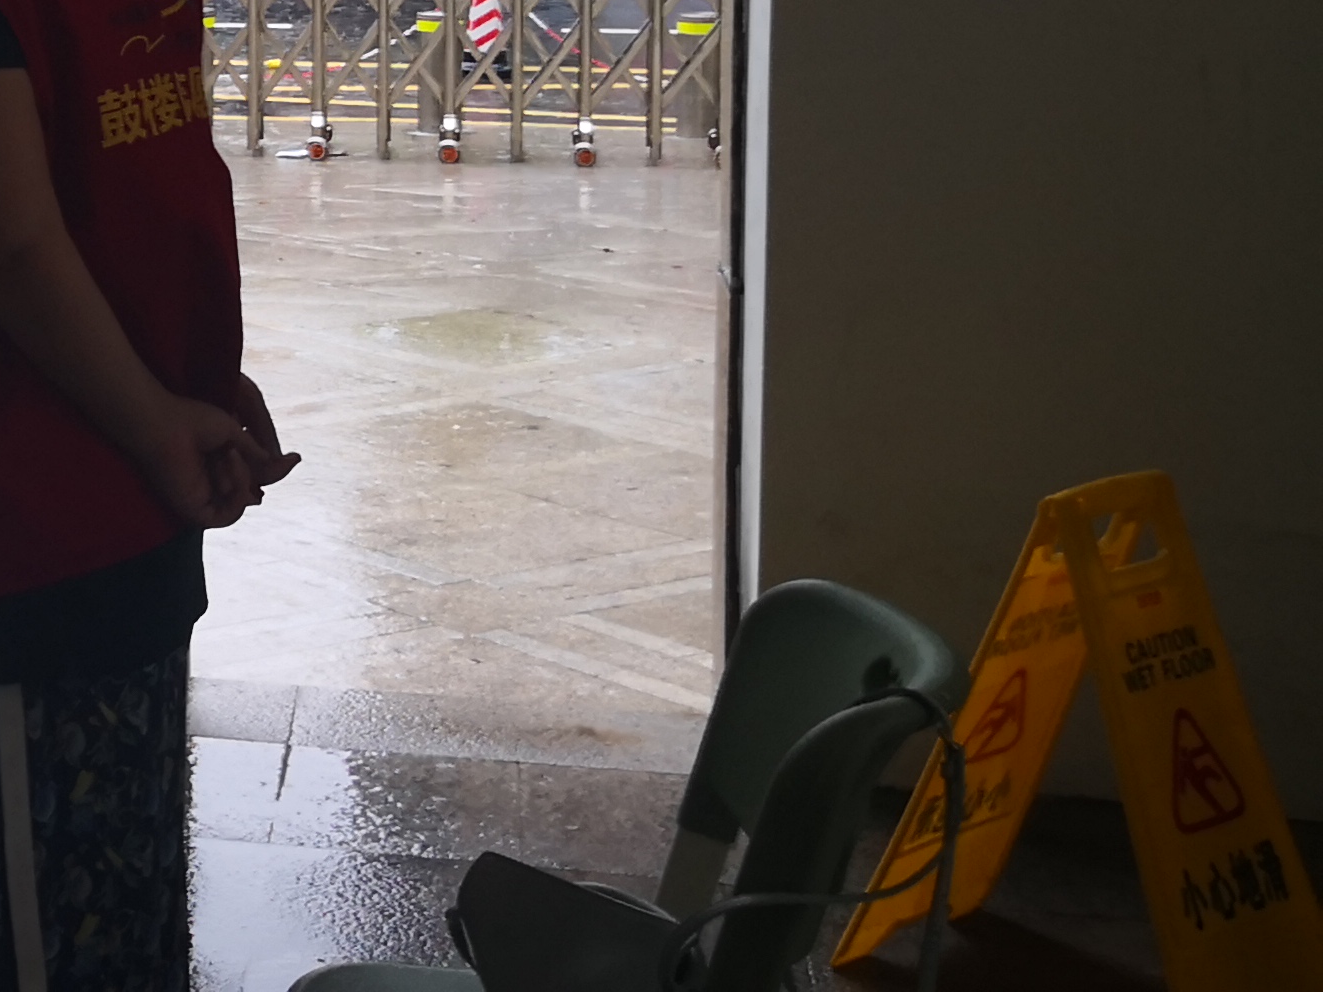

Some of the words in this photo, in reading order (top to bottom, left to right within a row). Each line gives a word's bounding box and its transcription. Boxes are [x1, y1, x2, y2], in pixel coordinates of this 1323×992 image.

[1125, 625, 1198, 665] CAUTION
[1121, 662, 1157, 694] WET
[1160, 646, 1217, 683] FLOOR
[1180, 839, 1291, 931] 小心地滑
